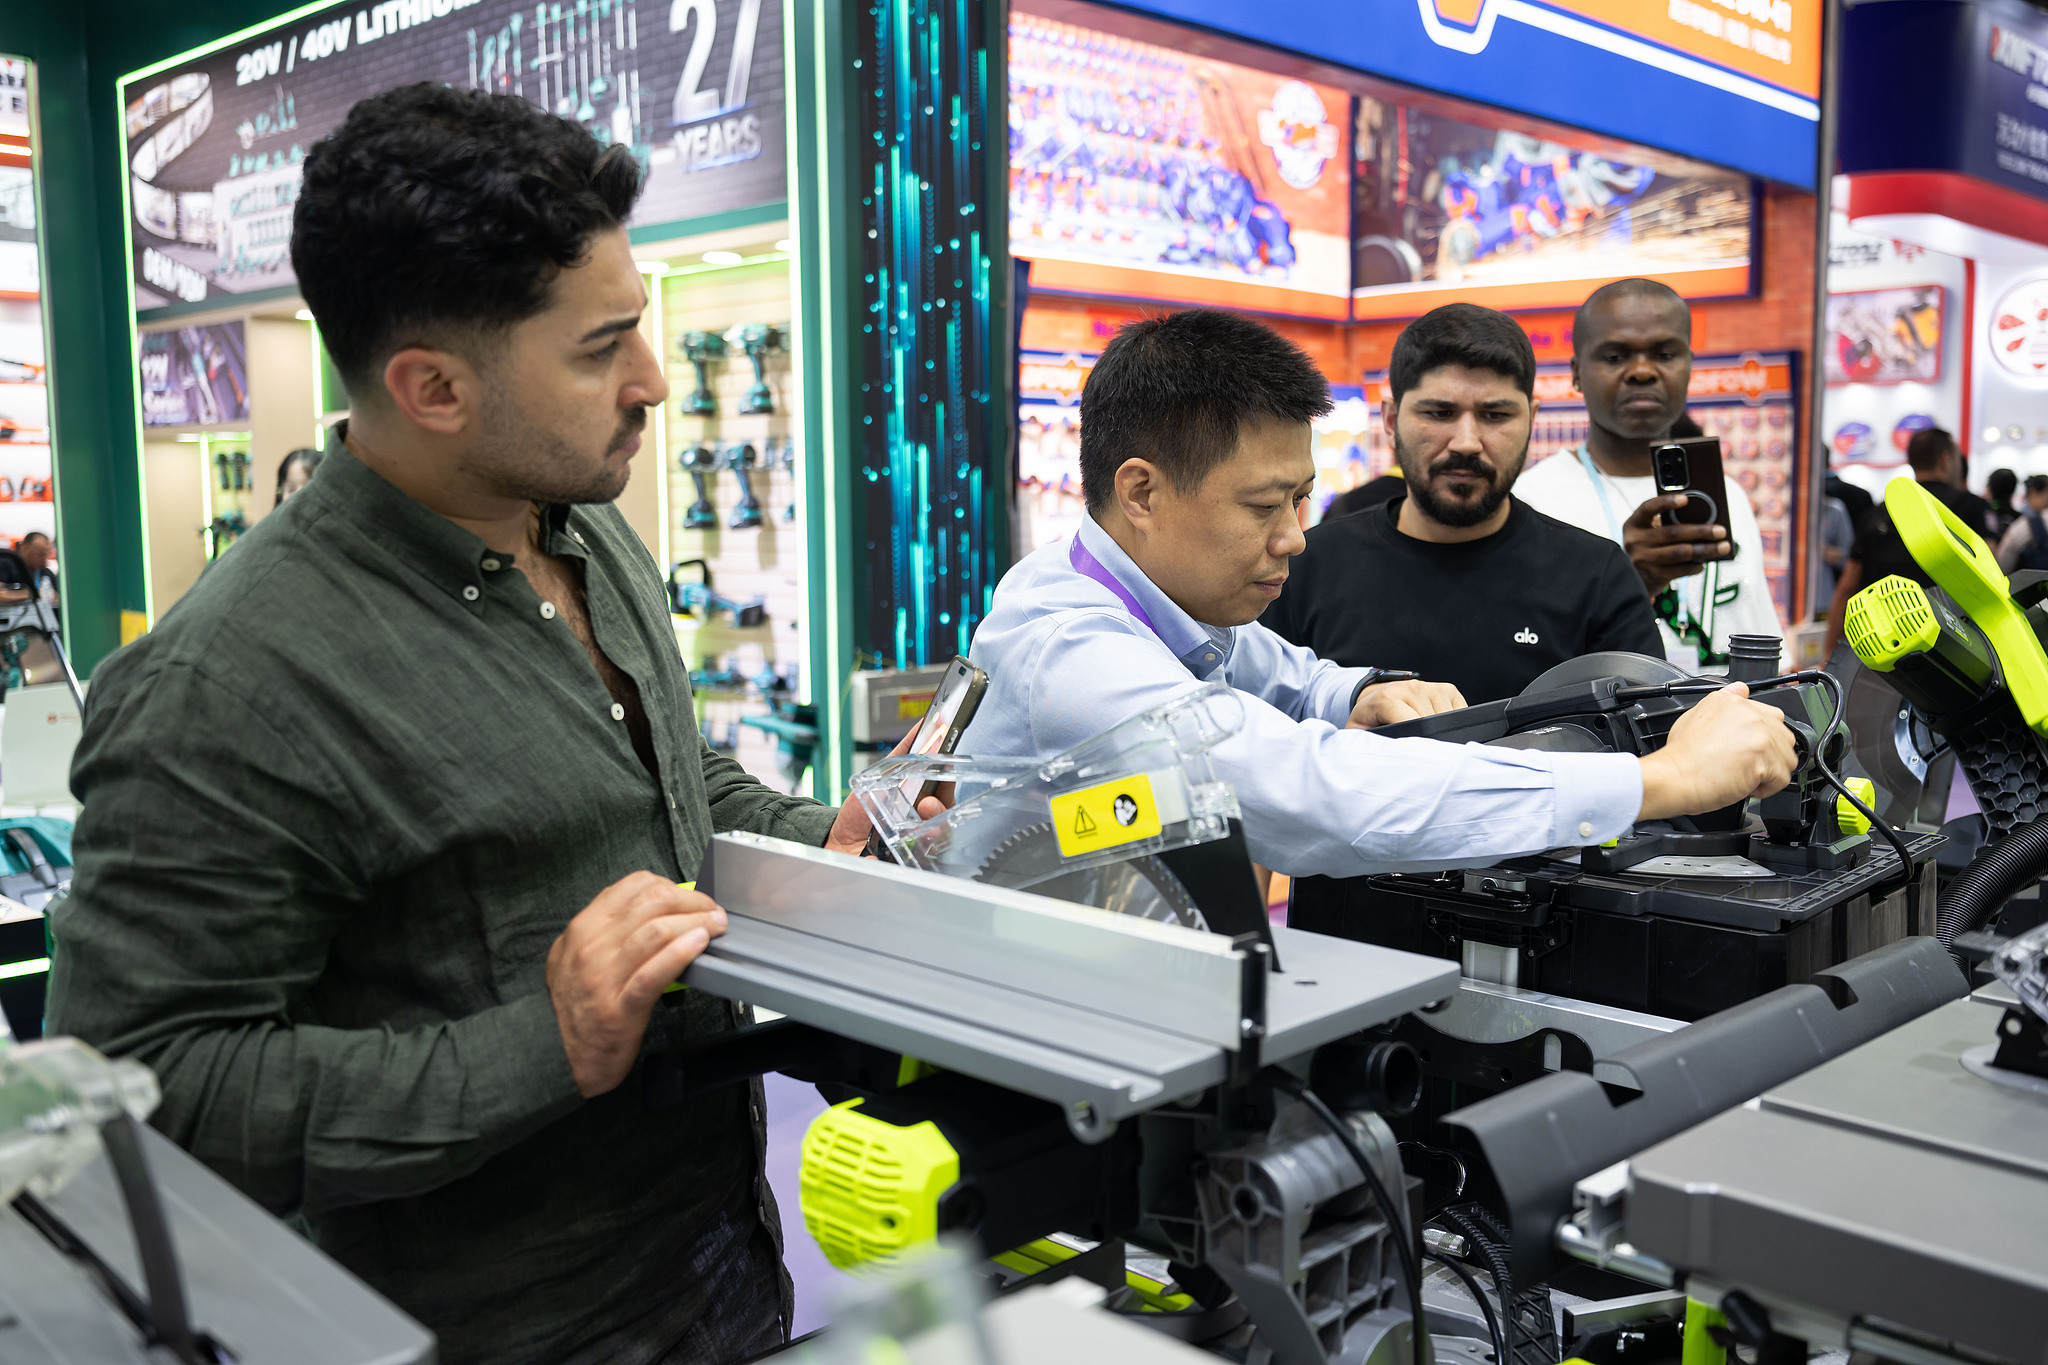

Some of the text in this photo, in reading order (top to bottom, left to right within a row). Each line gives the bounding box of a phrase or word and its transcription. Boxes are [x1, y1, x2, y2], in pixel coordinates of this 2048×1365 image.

[236, 0, 482, 87] 20V / 40V LITHIU
[672, 113, 763, 171] YEARS
[1513, 626, 1539, 645] alo
